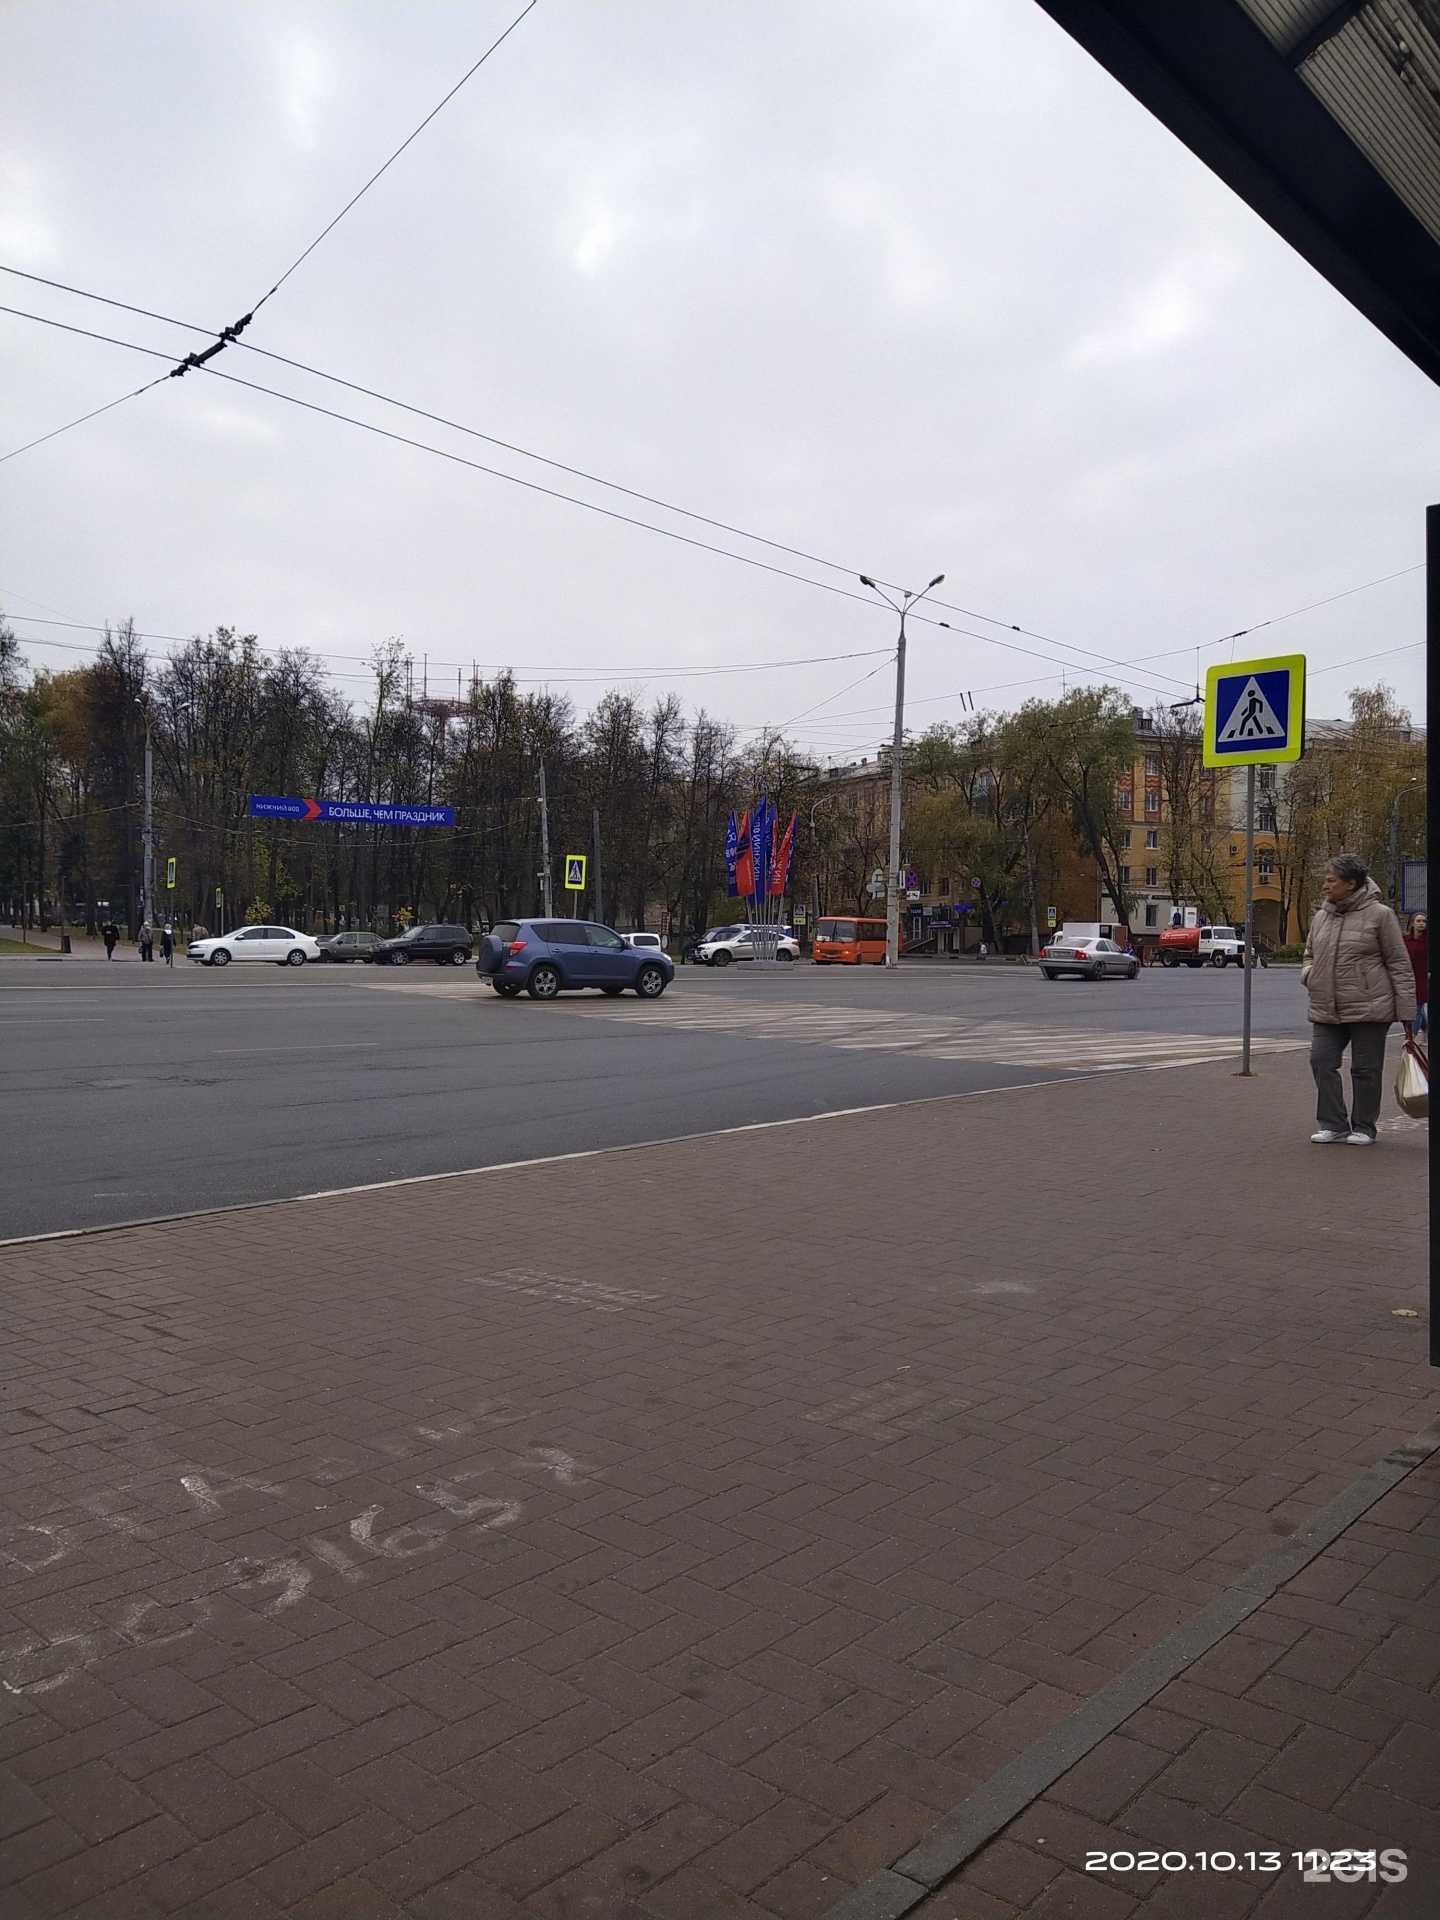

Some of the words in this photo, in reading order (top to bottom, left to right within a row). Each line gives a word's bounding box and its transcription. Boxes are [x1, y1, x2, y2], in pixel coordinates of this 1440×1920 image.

[328, 806, 372, 819] БОЛЬШЕ,
[373, 808, 393, 820] ЧЕМ
[394, 810, 446, 823] ПРАЗДНИК
